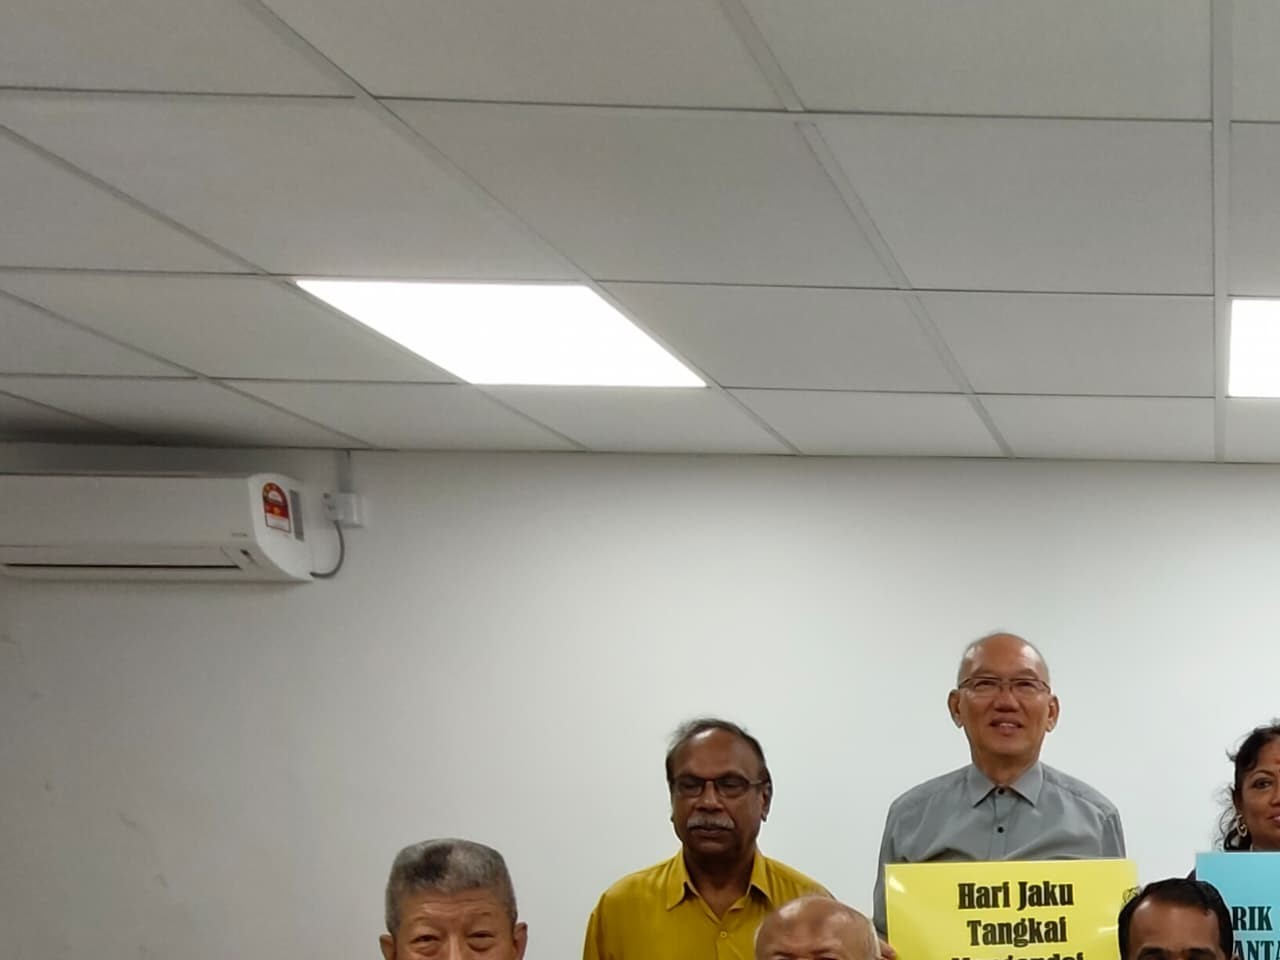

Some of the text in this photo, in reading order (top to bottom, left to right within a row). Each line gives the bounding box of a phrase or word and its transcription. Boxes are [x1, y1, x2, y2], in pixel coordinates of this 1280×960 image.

[957, 880, 1075, 912] Hari Jaku
[966, 916, 1068, 948] Tangkai
[1232, 906, 1272, 931] RIK
